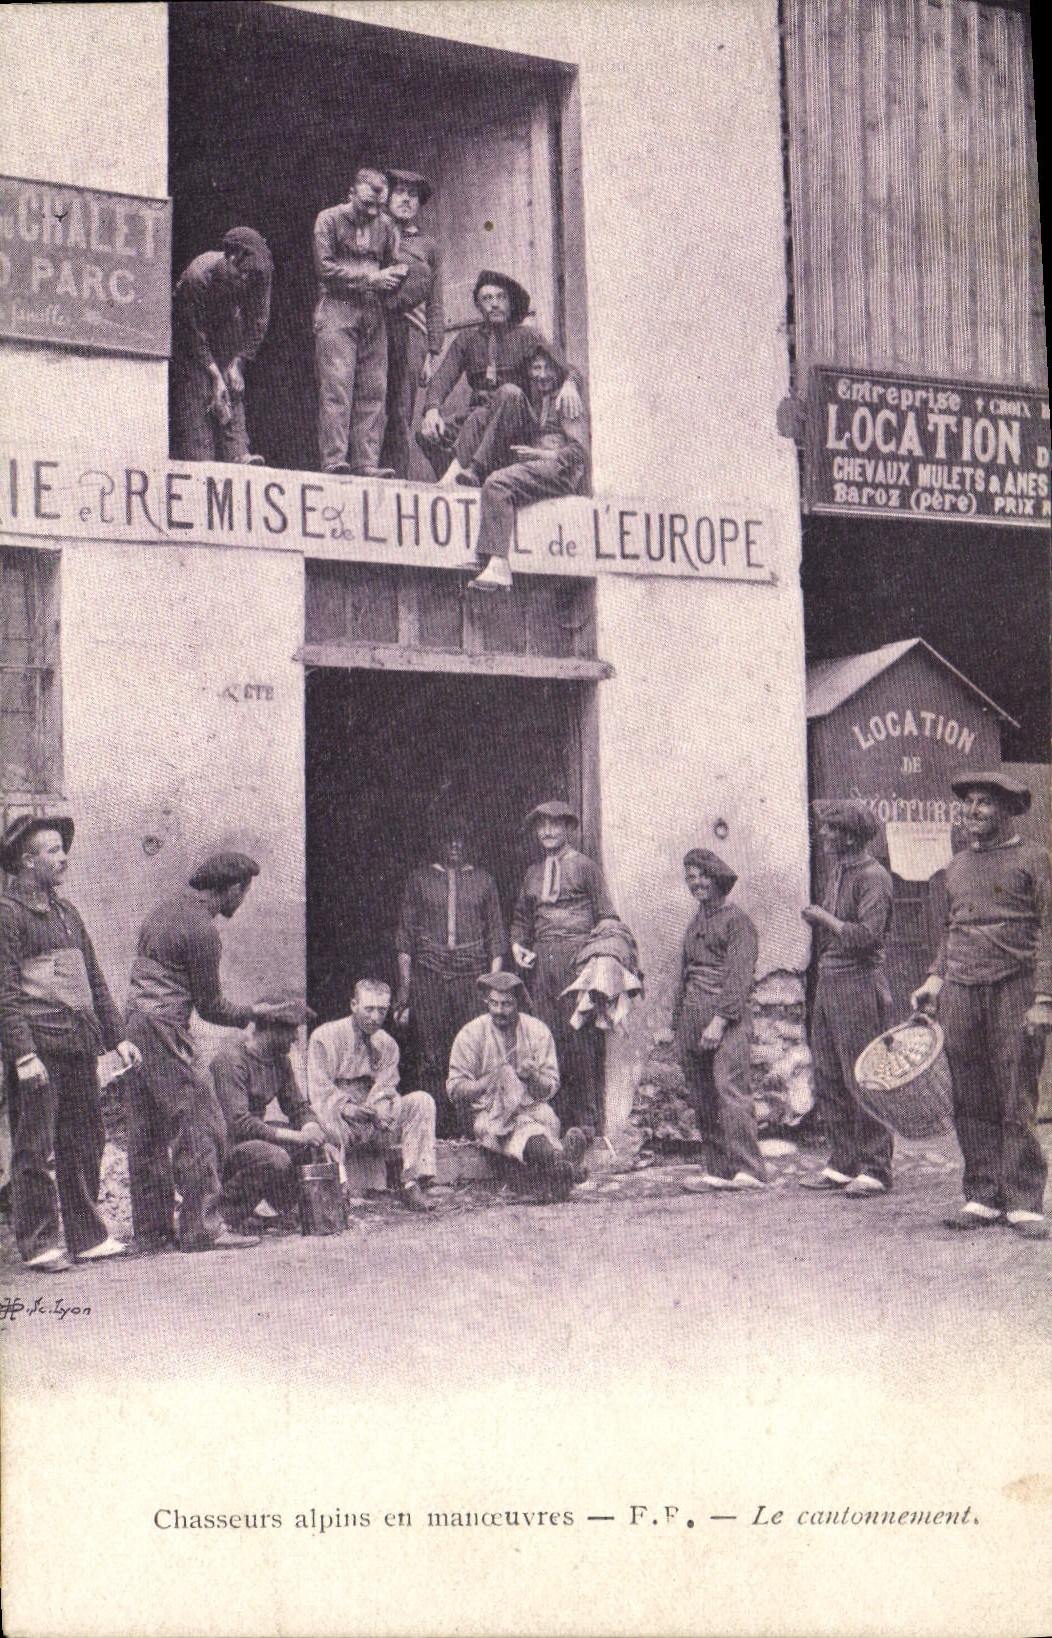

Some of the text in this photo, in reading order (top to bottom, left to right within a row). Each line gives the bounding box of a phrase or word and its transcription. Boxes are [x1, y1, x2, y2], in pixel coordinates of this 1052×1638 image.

[19, 189, 163, 259] CHALET
[838, 378, 961, 413] Entreprise
[826, 403, 1020, 466] LOCATION
[833, 455, 910, 487] CHEVAUX
[918, 463, 985, 493] MULETS
[0, 459, 61, 521] IE
[125, 467, 324, 539] REMISE
[548, 523, 577, 557] de
[593, 504, 765, 571] L'EUROPE
[833, 482, 901, 507] Baroz
[910, 488, 977, 517] (père)
[994, 496, 1034, 516] PRIX
[852, 709, 975, 755] LOCATION
[901, 756, 922, 773] DE
[850, 787, 966, 826] VOITURE
